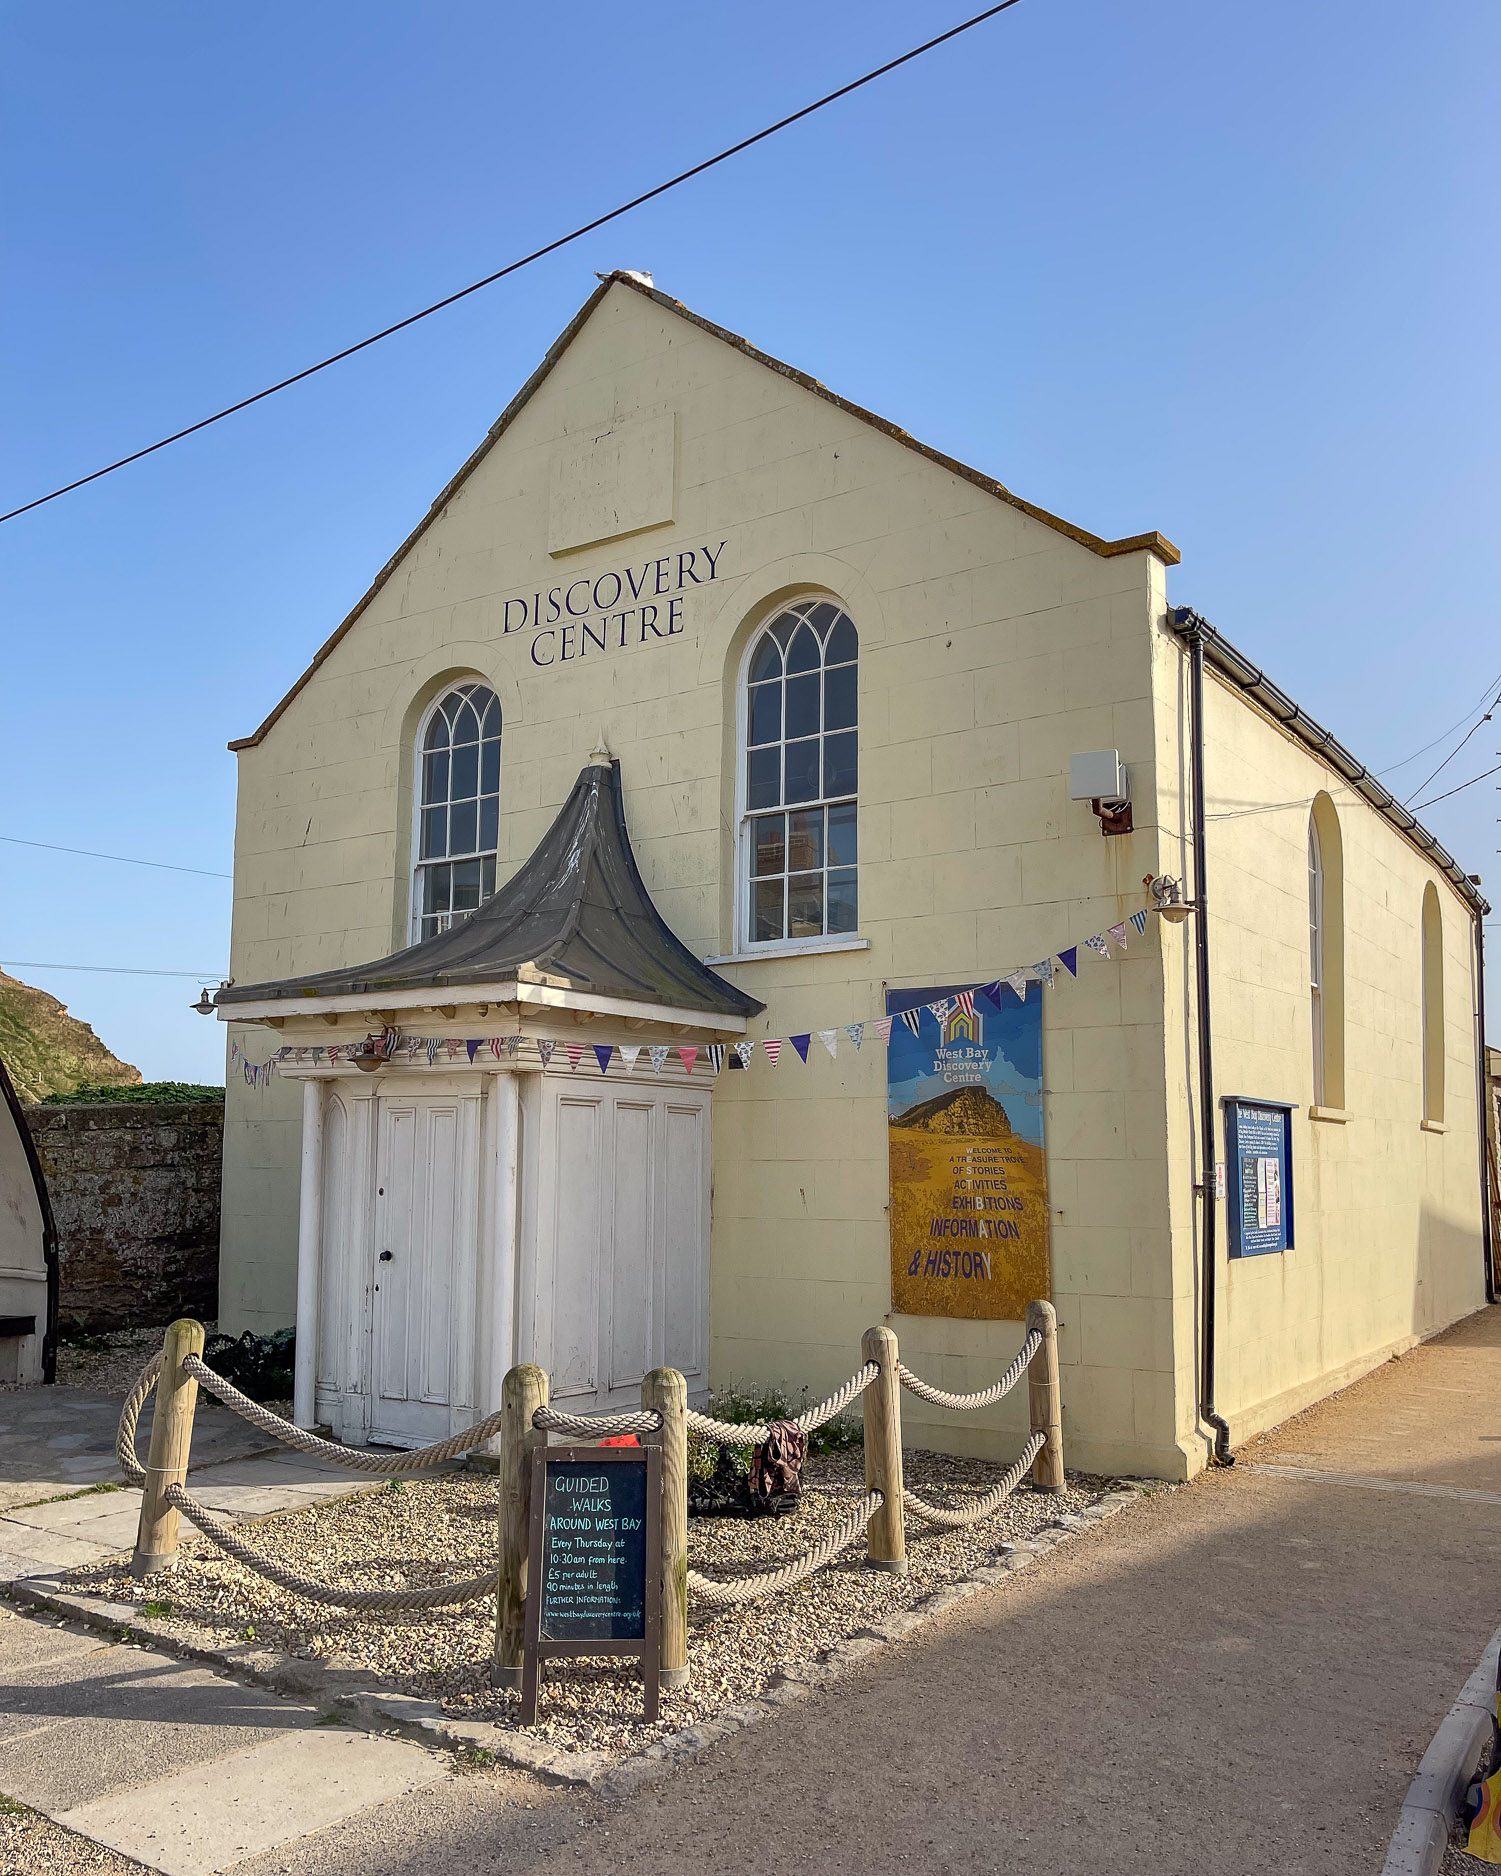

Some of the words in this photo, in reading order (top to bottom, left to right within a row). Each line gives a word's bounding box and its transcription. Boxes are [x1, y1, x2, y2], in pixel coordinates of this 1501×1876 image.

[502, 540, 728, 634] DISCOVERY
[530, 597, 684, 666] CENTRE
[935, 1048, 963, 1059] West
[965, 1047, 989, 1060] Bay
[933, 1060, 992, 1072] Discovery
[943, 1072, 982, 1083] Centre
[952, 1166, 964, 1174] OF
[966, 1166, 1005, 1175] STORIES
[953, 1179, 1007, 1191] ACTIVITIES
[952, 1196, 1024, 1211] EXHIBITIONS
[930, 1218, 1020, 1239] INFORMATION
[907, 1250, 921, 1277] &
[924, 1251, 992, 1280] HISTORY
[555, 1476, 609, 1493] GUIDED
[572, 1497, 612, 1512] WALKS
[550, 1516, 592, 1530] AROUND
[595, 1517, 619, 1531] WEST
[621, 1517, 642, 1530] BAY
[551, 1536, 572, 1550] Every
[574, 1536, 613, 1550] Thursday
[615, 1539, 625, 1548] at
[588, 1555, 605, 1565] from
[548, 1567, 561, 1580] £5
[562, 1571, 575, 1580] per
[575, 1569, 598, 1579] adult
[546, 1581, 558, 1592] 90
[559, 1582, 584, 1591] minutes
[596, 1580, 619, 1592] length
[546, 1595, 574, 1605] FURTHER
